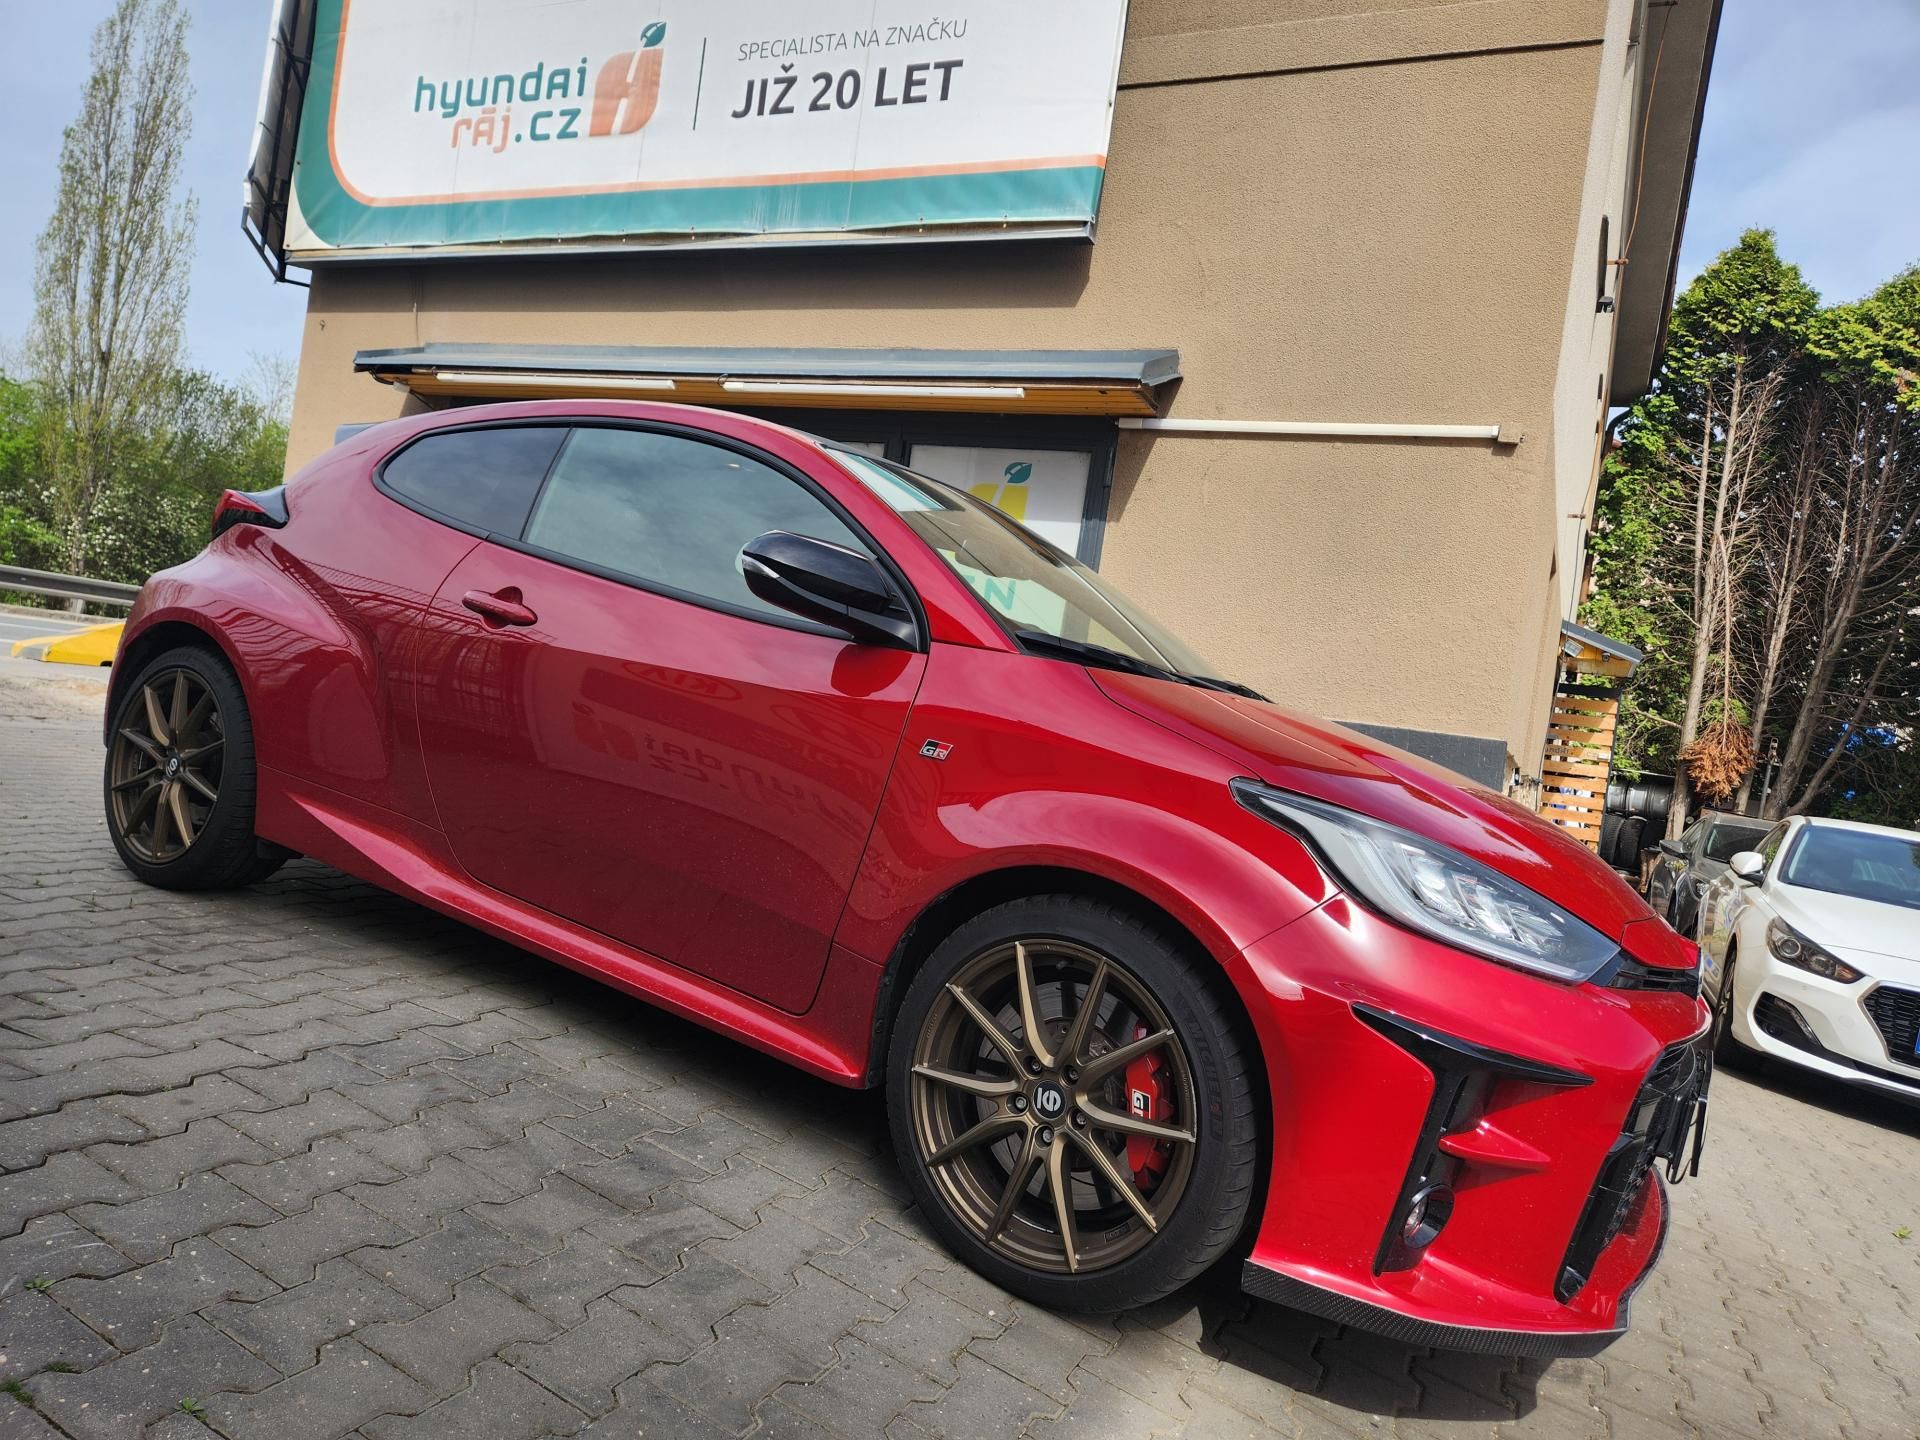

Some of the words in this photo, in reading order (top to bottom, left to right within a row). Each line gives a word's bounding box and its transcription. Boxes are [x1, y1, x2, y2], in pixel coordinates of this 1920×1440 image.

[738, 32, 848, 61] SPECIALISTA
[853, 29, 880, 49] NA
[885, 17, 968, 46] ZNAČKU
[414, 57, 588, 119] hyundai
[731, 62, 798, 119] JIŽ
[808, 68, 861, 112] 20
[874, 58, 964, 107] LET
